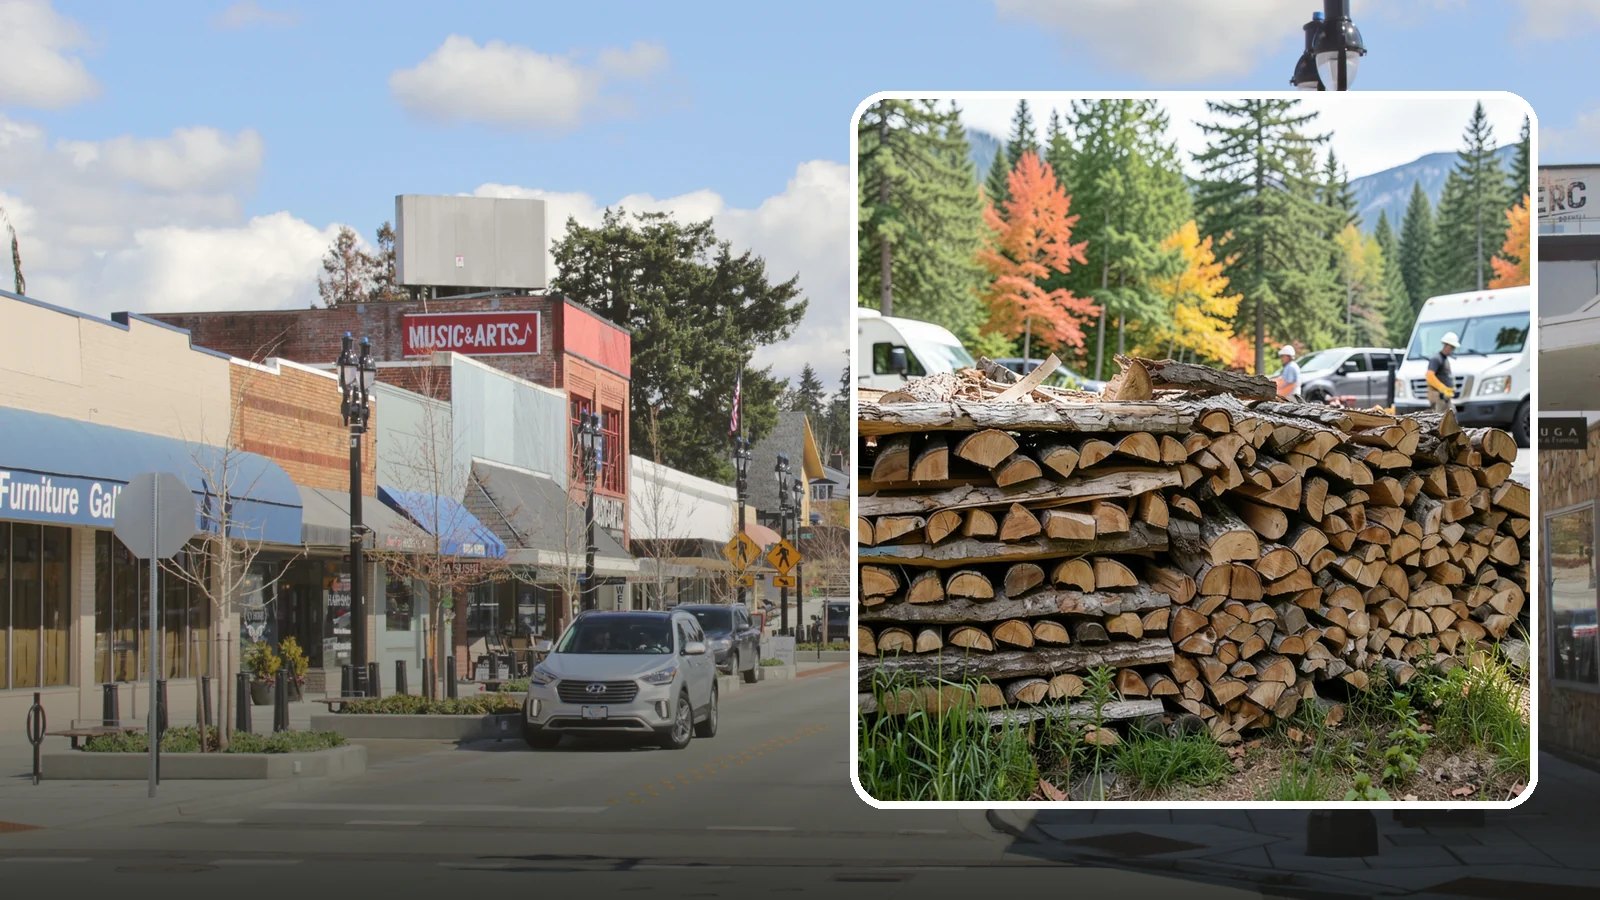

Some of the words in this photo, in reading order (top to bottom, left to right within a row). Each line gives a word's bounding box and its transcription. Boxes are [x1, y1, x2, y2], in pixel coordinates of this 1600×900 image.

[1540, 427, 1577, 436] UGA
[0, 471, 79, 515] Furniture
[90, 482, 121, 519] Gal
[454, 563, 479, 574] SUSHI
